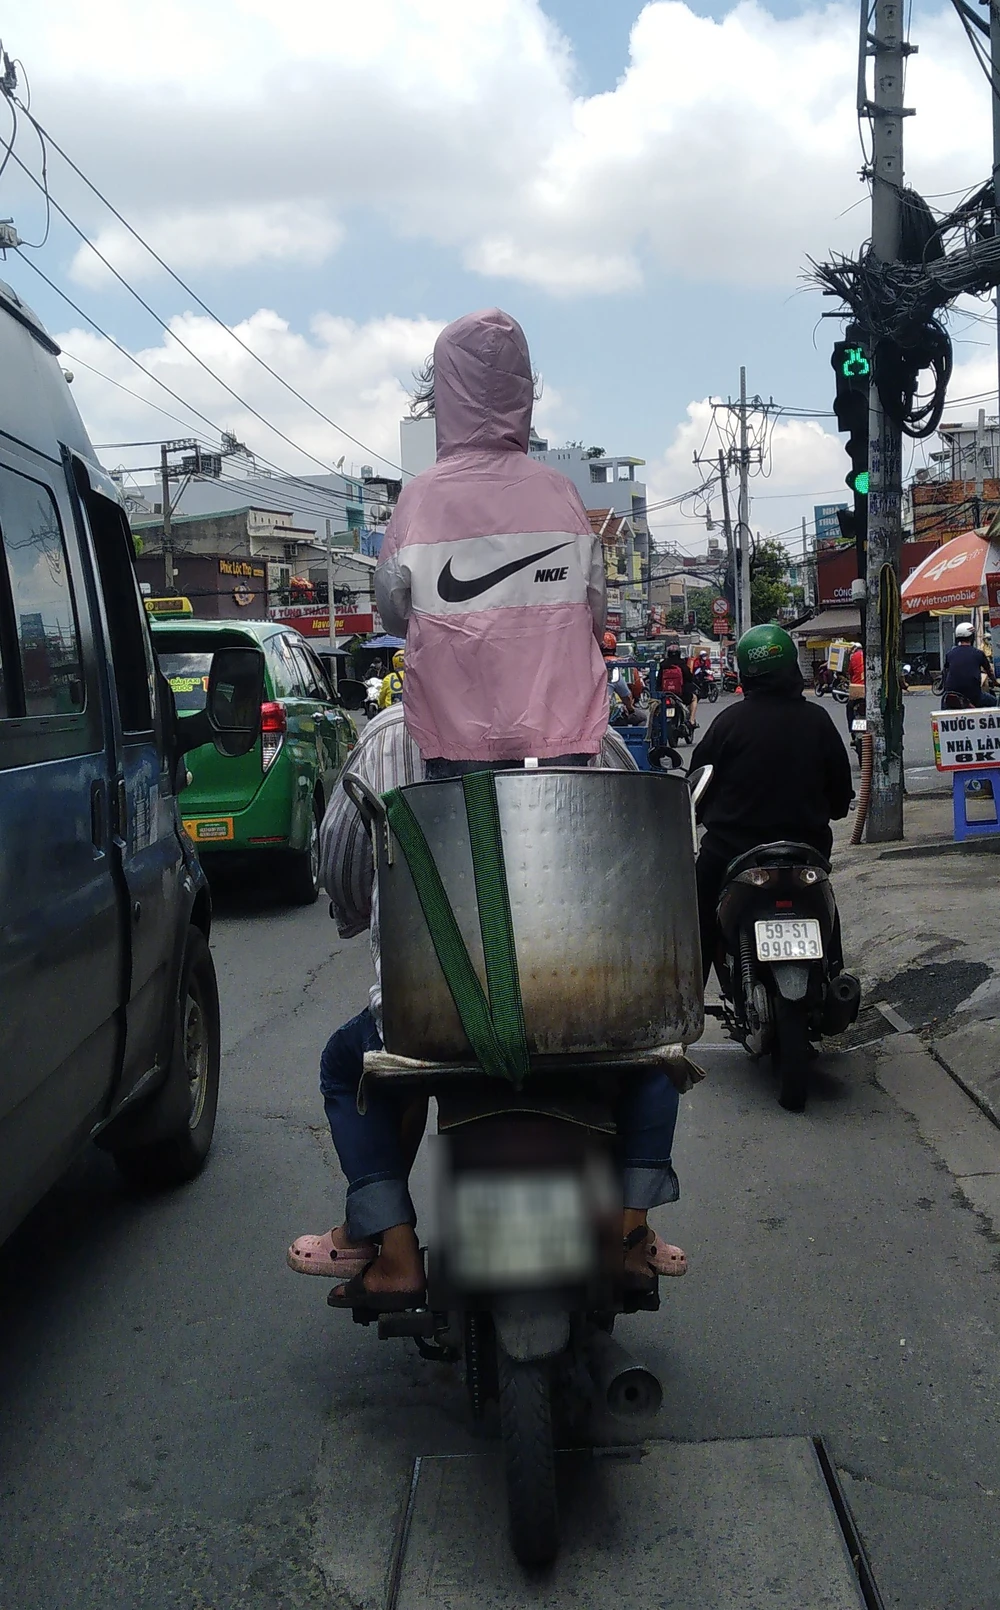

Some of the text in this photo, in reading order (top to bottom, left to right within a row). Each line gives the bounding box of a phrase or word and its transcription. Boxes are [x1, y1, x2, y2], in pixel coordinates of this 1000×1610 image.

[923, 552, 968, 581] 4G
[185, 677, 200, 685] TAXI
[941, 716, 976, 732] NƯỚC
[946, 736, 974, 753] NHÀ
[765, 923, 808, 940] 59-S1
